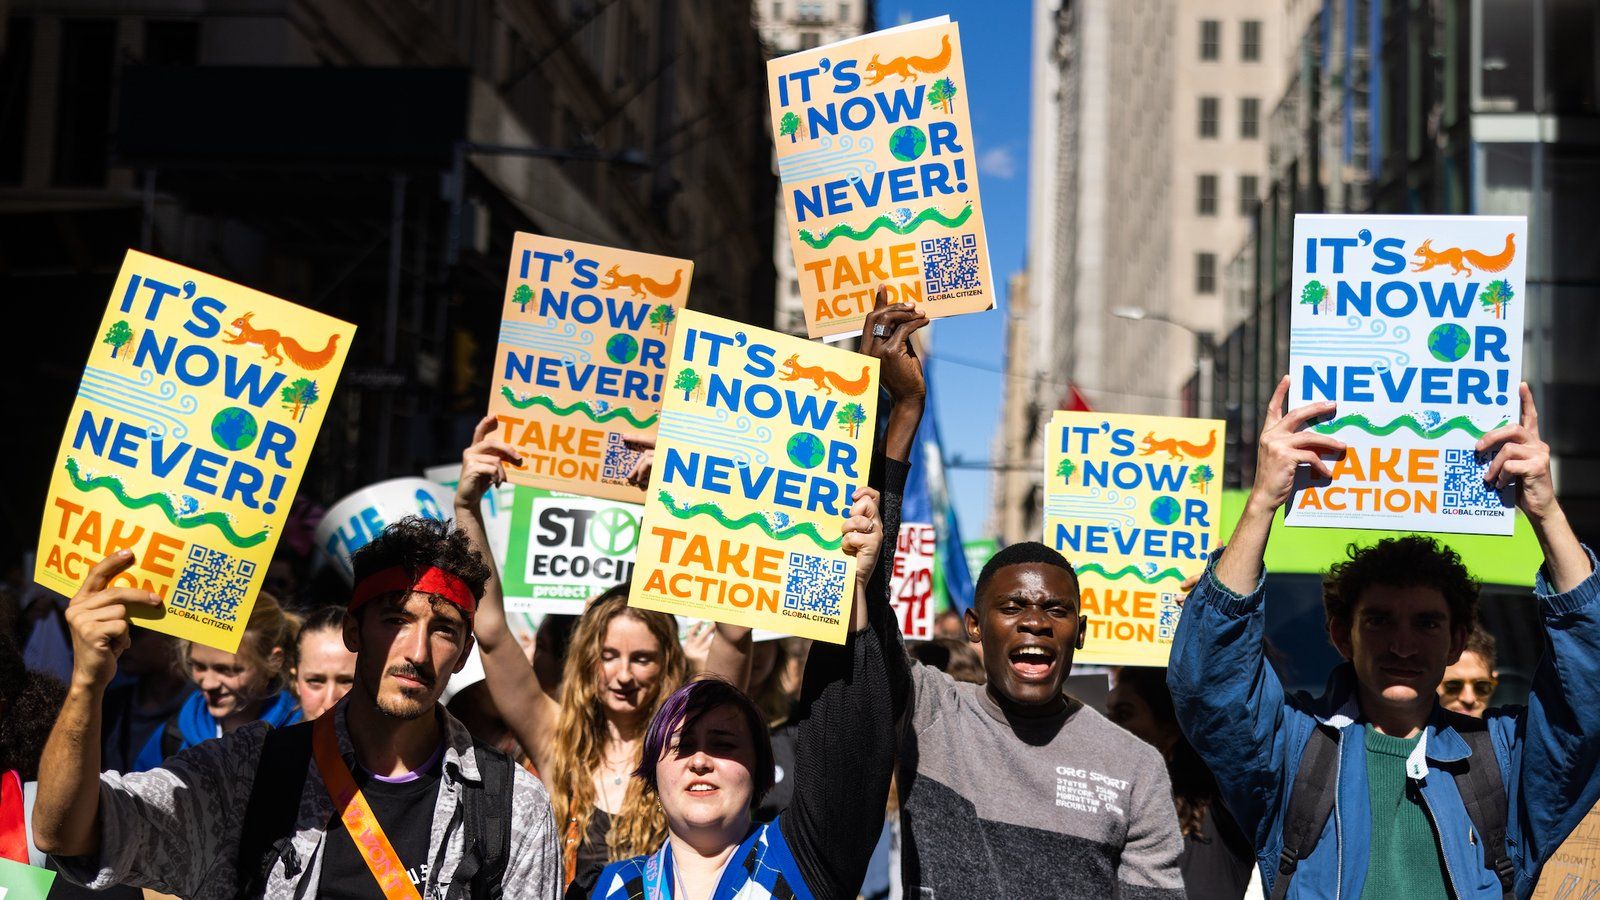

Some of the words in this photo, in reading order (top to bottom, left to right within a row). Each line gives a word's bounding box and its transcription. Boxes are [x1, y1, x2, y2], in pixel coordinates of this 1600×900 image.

[778, 57, 861, 108] IT'S
[807, 84, 926, 139] NOW
[889, 121, 964, 163] OR
[793, 158, 969, 222] NEVER!
[519, 249, 600, 289] IT'S
[804, 242, 920, 293] TAKE
[1306, 228, 1406, 275] IT'S
[120, 274, 227, 338] IT'S
[539, 288, 652, 331] NOW
[927, 293, 956, 302] GLOBAL
[956, 289, 983, 299] CITIZEN
[1336, 280, 1480, 318] NOW
[606, 333, 666, 370] OR
[683, 328, 777, 379] IT'S
[1427, 323, 1511, 363] OR
[132, 329, 287, 408] NOW
[504, 351, 664, 403] NEVER!
[1301, 365, 1509, 406] NEVER!
[705, 373, 838, 431] NOW
[211, 407, 297, 468] OR
[497, 415, 604, 458] TAKE
[786, 432, 859, 479] OR
[1061, 421, 1135, 457] IT'S
[72, 410, 287, 515] NEVER!
[502, 451, 600, 482] CTION
[601, 478, 624, 487] GLOBAL
[662, 447, 857, 520] NEVER!
[1082, 460, 1189, 492] NOW
[1150, 495, 1210, 528] OR
[1297, 486, 1437, 514] ACTION
[1442, 508, 1473, 517] GLOBAL
[1474, 509, 1505, 517] CITIZEN
[55, 497, 185, 578] TAKE
[537, 507, 643, 556] STO
[1056, 523, 1209, 561] NEVER!
[45, 544, 170, 601] ACTON
[533, 554, 635, 581] ECOCI
[651, 526, 785, 584] TAKE
[643, 569, 781, 614] ACTION
[1080, 588, 1156, 619] AKE
[168, 607, 200, 624] GLOBAL
[202, 617, 234, 632] CITIZEN
[782, 609, 811, 621] GLOBAL
[812, 614, 840, 626] CITIZEN
[1088, 619, 1155, 643] TION
[1056, 766, 1086, 779] ORG
[1089, 771, 1129, 790] SPORT
